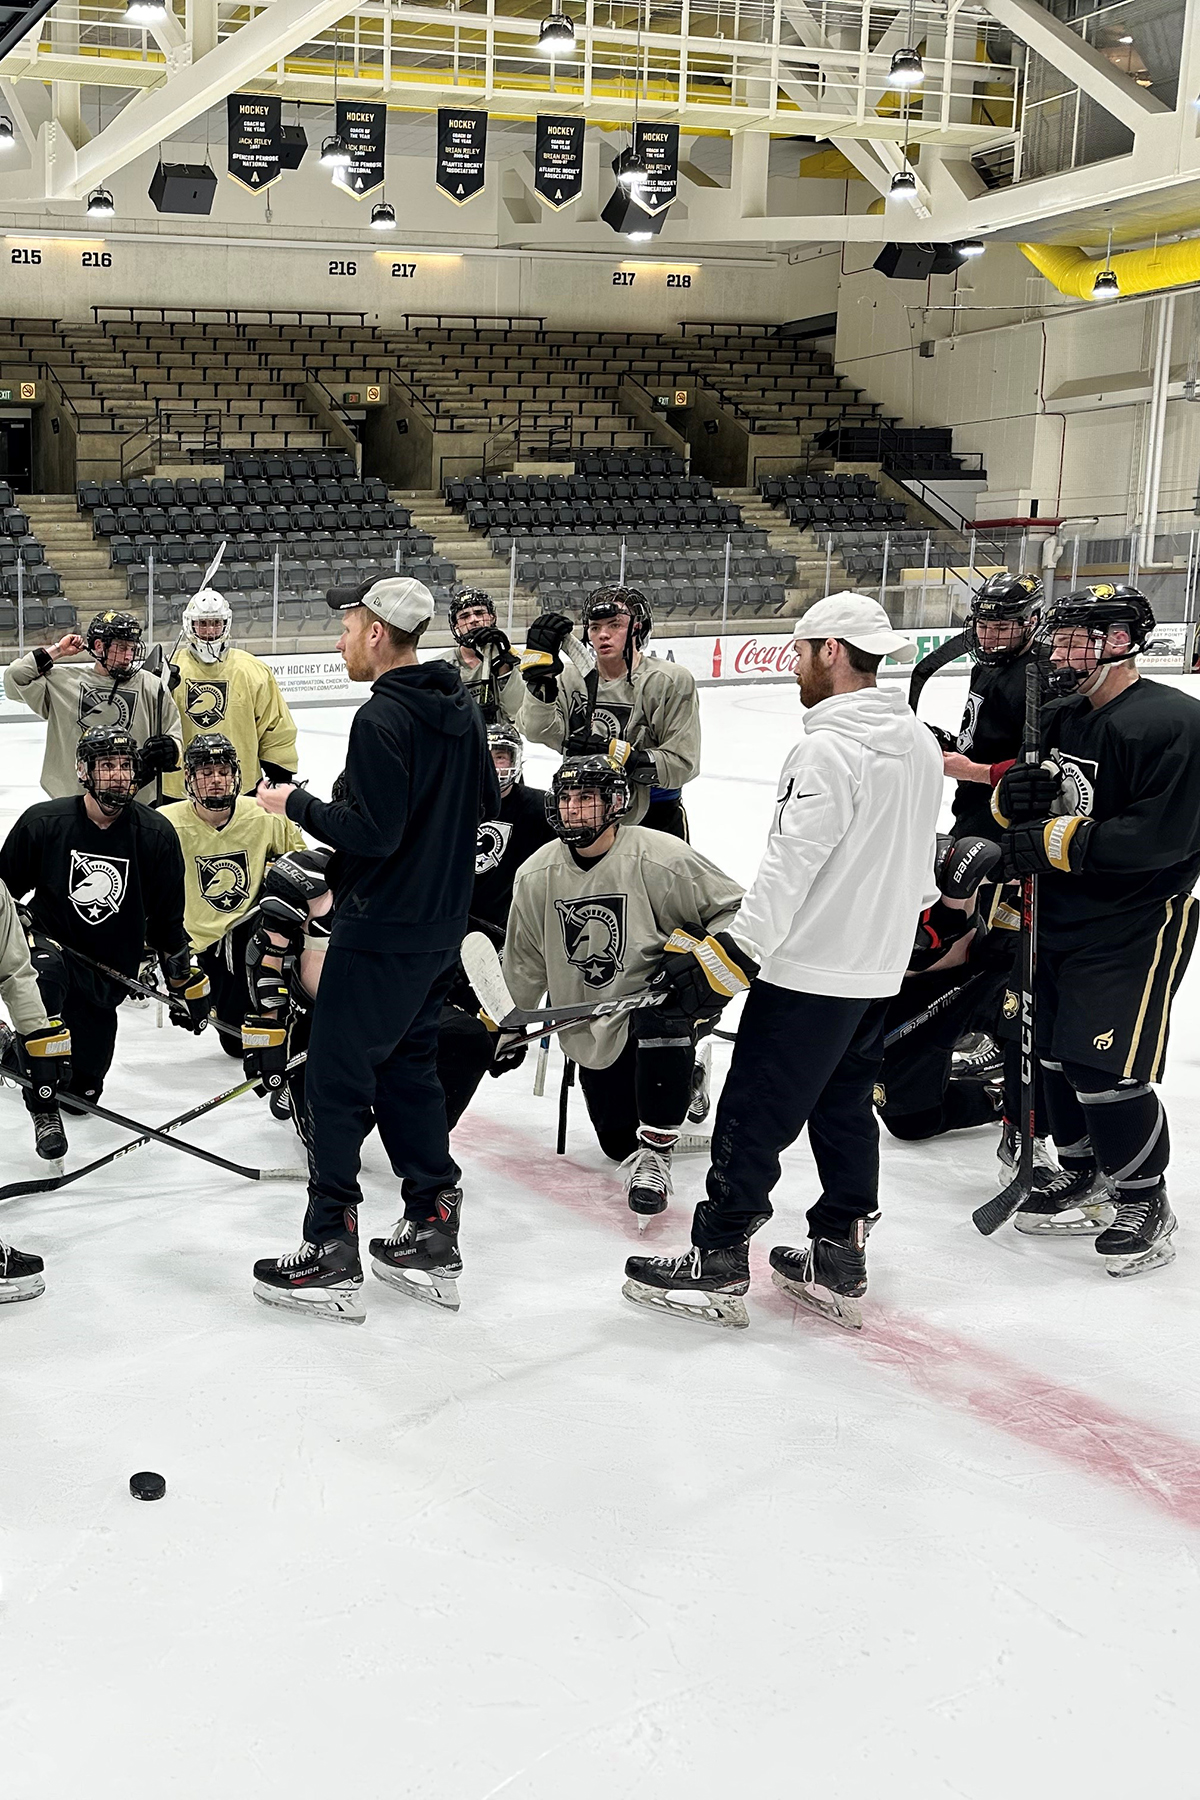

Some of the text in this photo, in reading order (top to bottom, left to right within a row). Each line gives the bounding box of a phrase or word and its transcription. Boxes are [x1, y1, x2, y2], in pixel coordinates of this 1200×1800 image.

[239, 104, 269, 116] HOCKEY
[346, 112, 375, 122] HOCKEY
[448, 119, 476, 129] HOCKEY
[547, 126, 575, 136] HOCKEY
[642, 132, 669, 142] HOCKEY
[254, 138, 272, 146] RILEY
[242, 160, 268, 168] NATIONAL
[10, 248, 42, 265] 215
[81, 251, 113, 268] 216
[328, 261, 357, 276] 216
[391, 263, 417, 278] 217
[612, 272, 636, 286] 217
[666, 274, 691, 289] 218
[980, 602, 996, 610] ARMY
[735, 638, 799, 673] Coca-Co
[287, 664, 321, 675] HOCKEY
[561, 771, 577, 779] ARMY
[953, 841, 986, 884] BAUER
[592, 991, 669, 1016] CCM
[1021, 990, 1033, 1085] CCM
[393, 1248, 417, 1258] BAUER
[289, 1266, 320, 1280] BAUER
